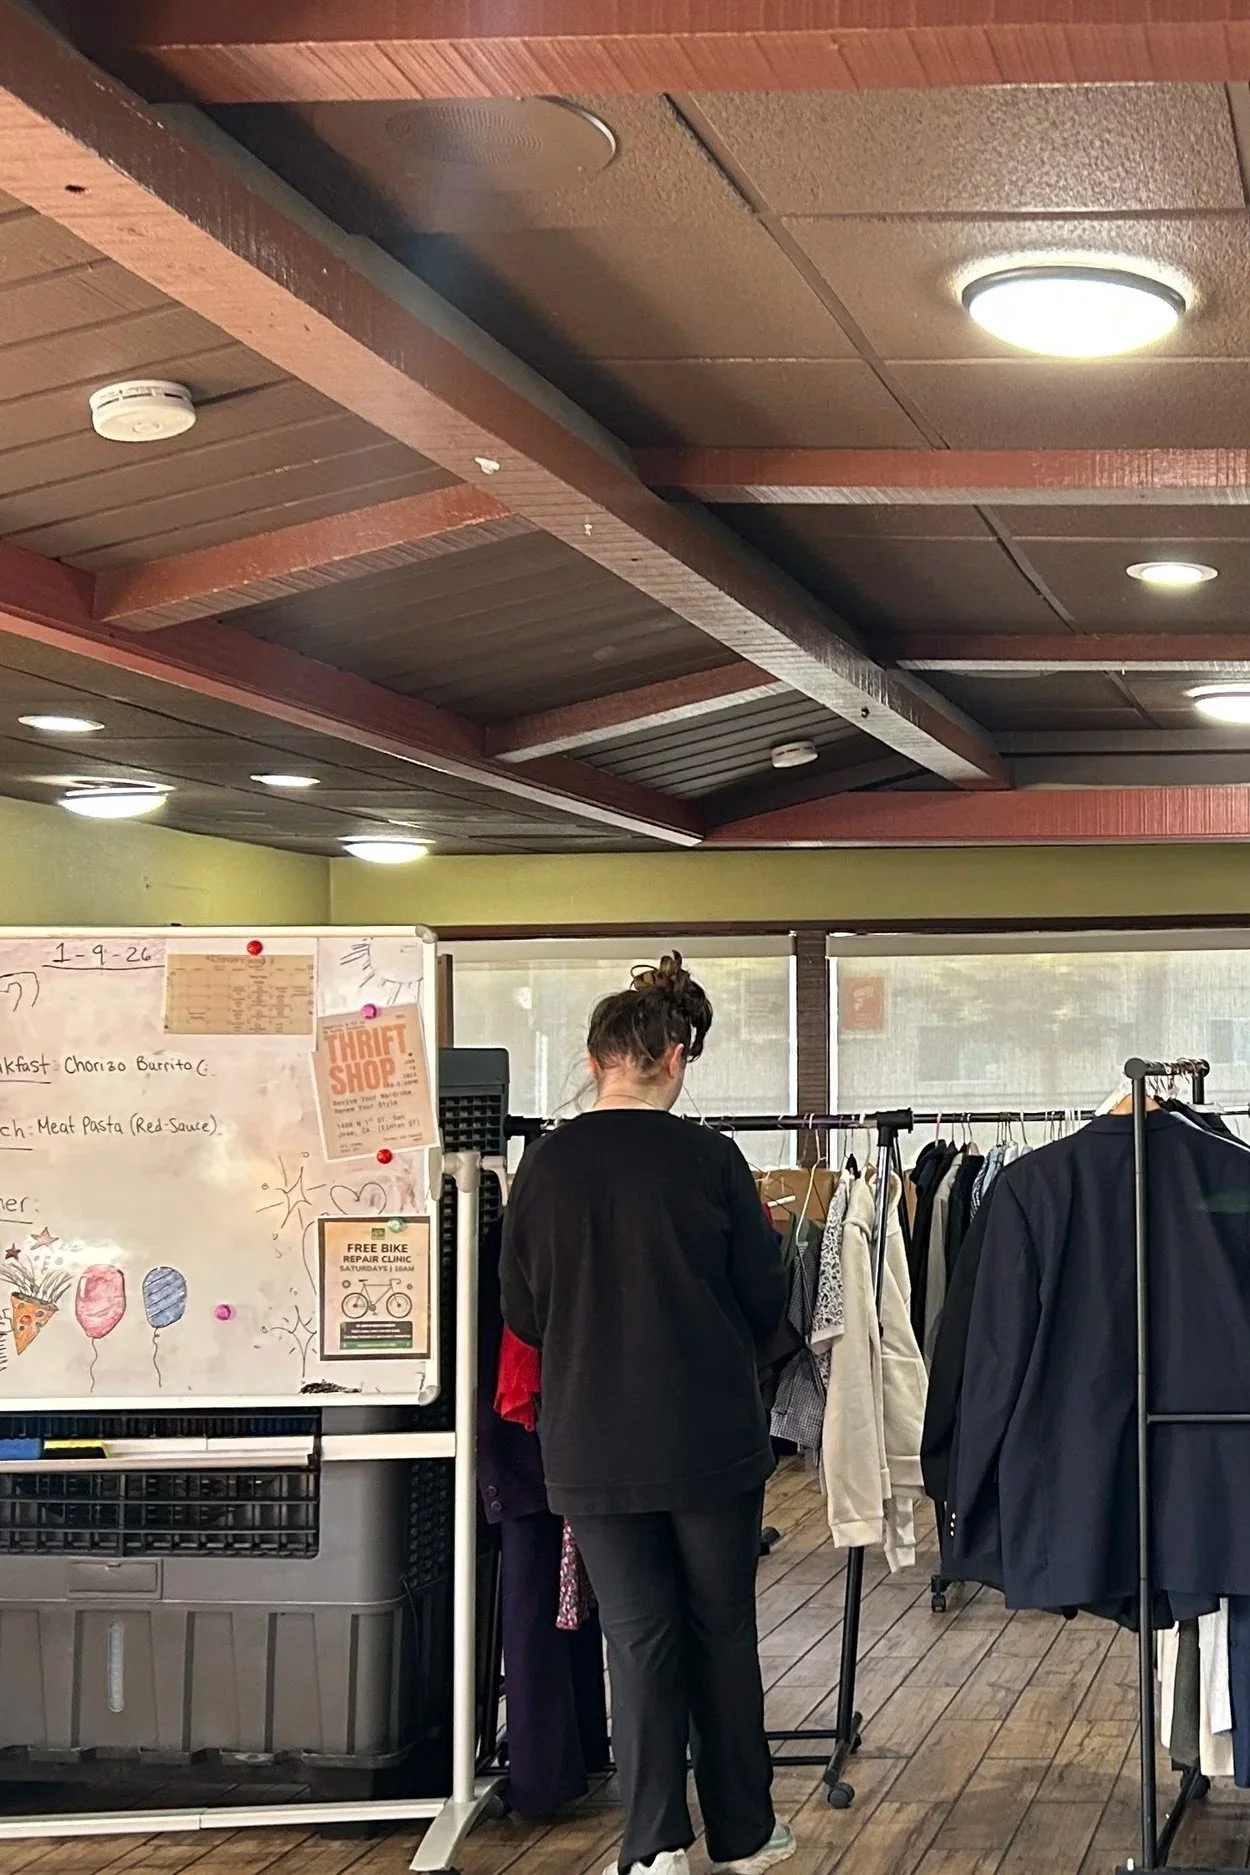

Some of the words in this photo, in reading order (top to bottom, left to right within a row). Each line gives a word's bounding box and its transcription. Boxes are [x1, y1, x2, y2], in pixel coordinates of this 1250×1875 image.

[323, 1023, 407, 1065] THRIFT
[64, 1055, 127, 1075] Chorizo
[136, 1055, 193, 1072] Burrito
[329, 1057, 396, 1096] SHOP
[37, 1115, 75, 1135] Meat
[82, 1115, 124, 1136] Pasta
[347, 1243, 378, 1253] FREE
[381, 1243, 408, 1253] BIKE
[339, 1265, 388, 1273] SATURDAYS
[343, 1255, 379, 1264] REPAIR
[381, 1255, 412, 1264] CLINIC
